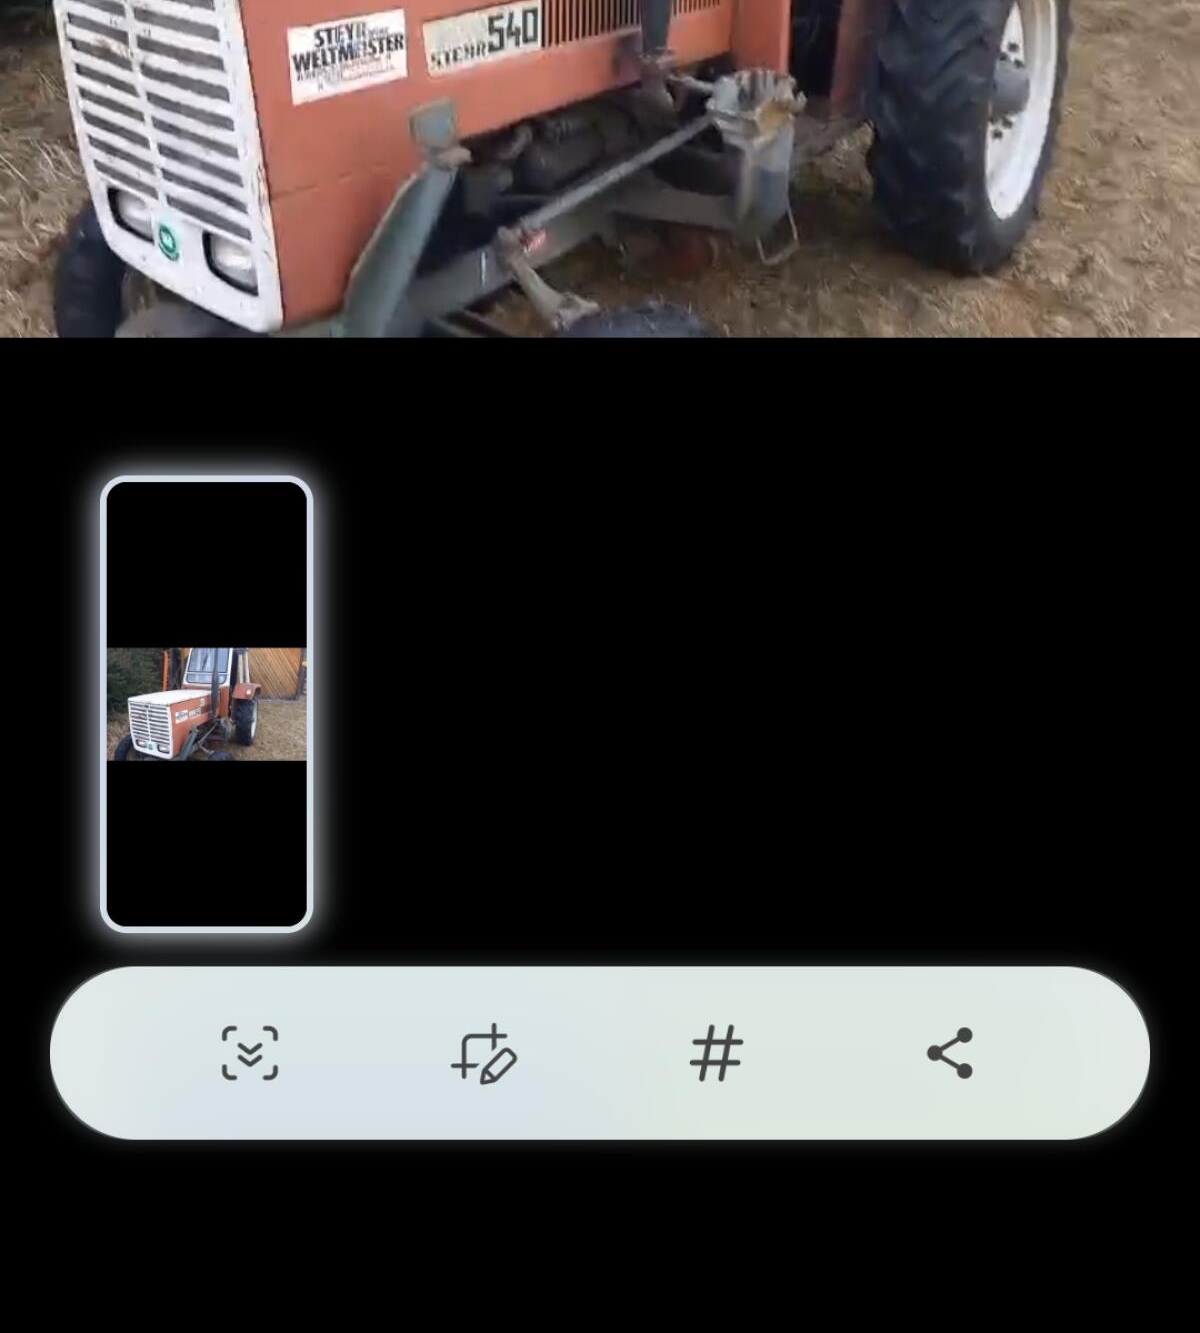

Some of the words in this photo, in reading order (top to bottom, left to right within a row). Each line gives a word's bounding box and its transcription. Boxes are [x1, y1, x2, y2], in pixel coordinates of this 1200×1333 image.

[314, 22, 367, 48] STEYR
[487, 7, 539, 53] 540
[292, 33, 404, 72] WELTMEISTER
